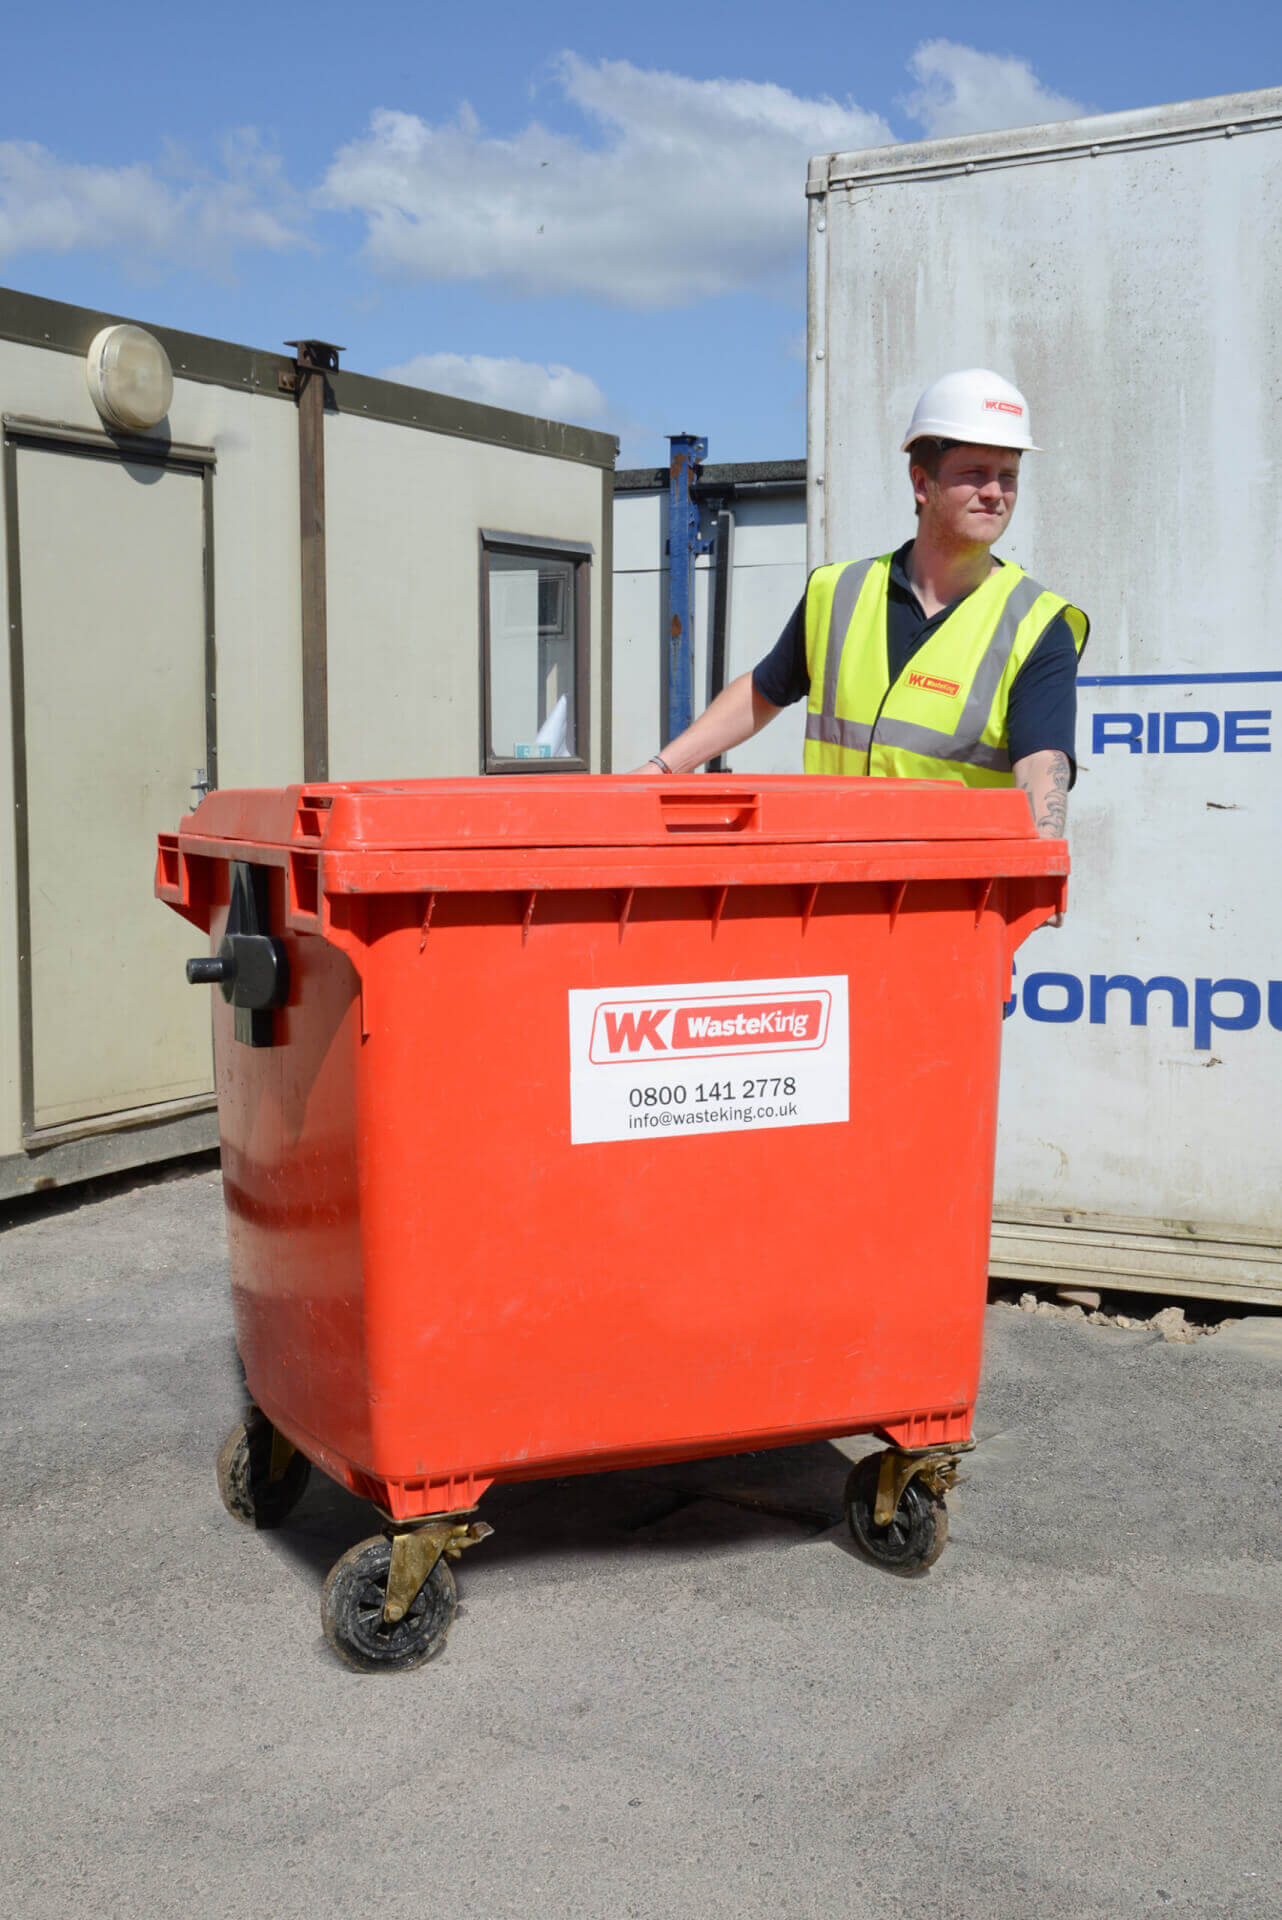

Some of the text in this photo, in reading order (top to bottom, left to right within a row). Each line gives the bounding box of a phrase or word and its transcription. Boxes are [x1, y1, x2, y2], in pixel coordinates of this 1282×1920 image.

[908, 673, 925, 687] WK
[1092, 710, 1272, 754] RIDE
[1003, 959, 1282, 1050] omp
[604, 1008, 809, 1053] WK WasteKing
[629, 1077, 796, 1107] 0800 141 2778
[628, 1103, 798, 1129] info@wasteking.co.uk
